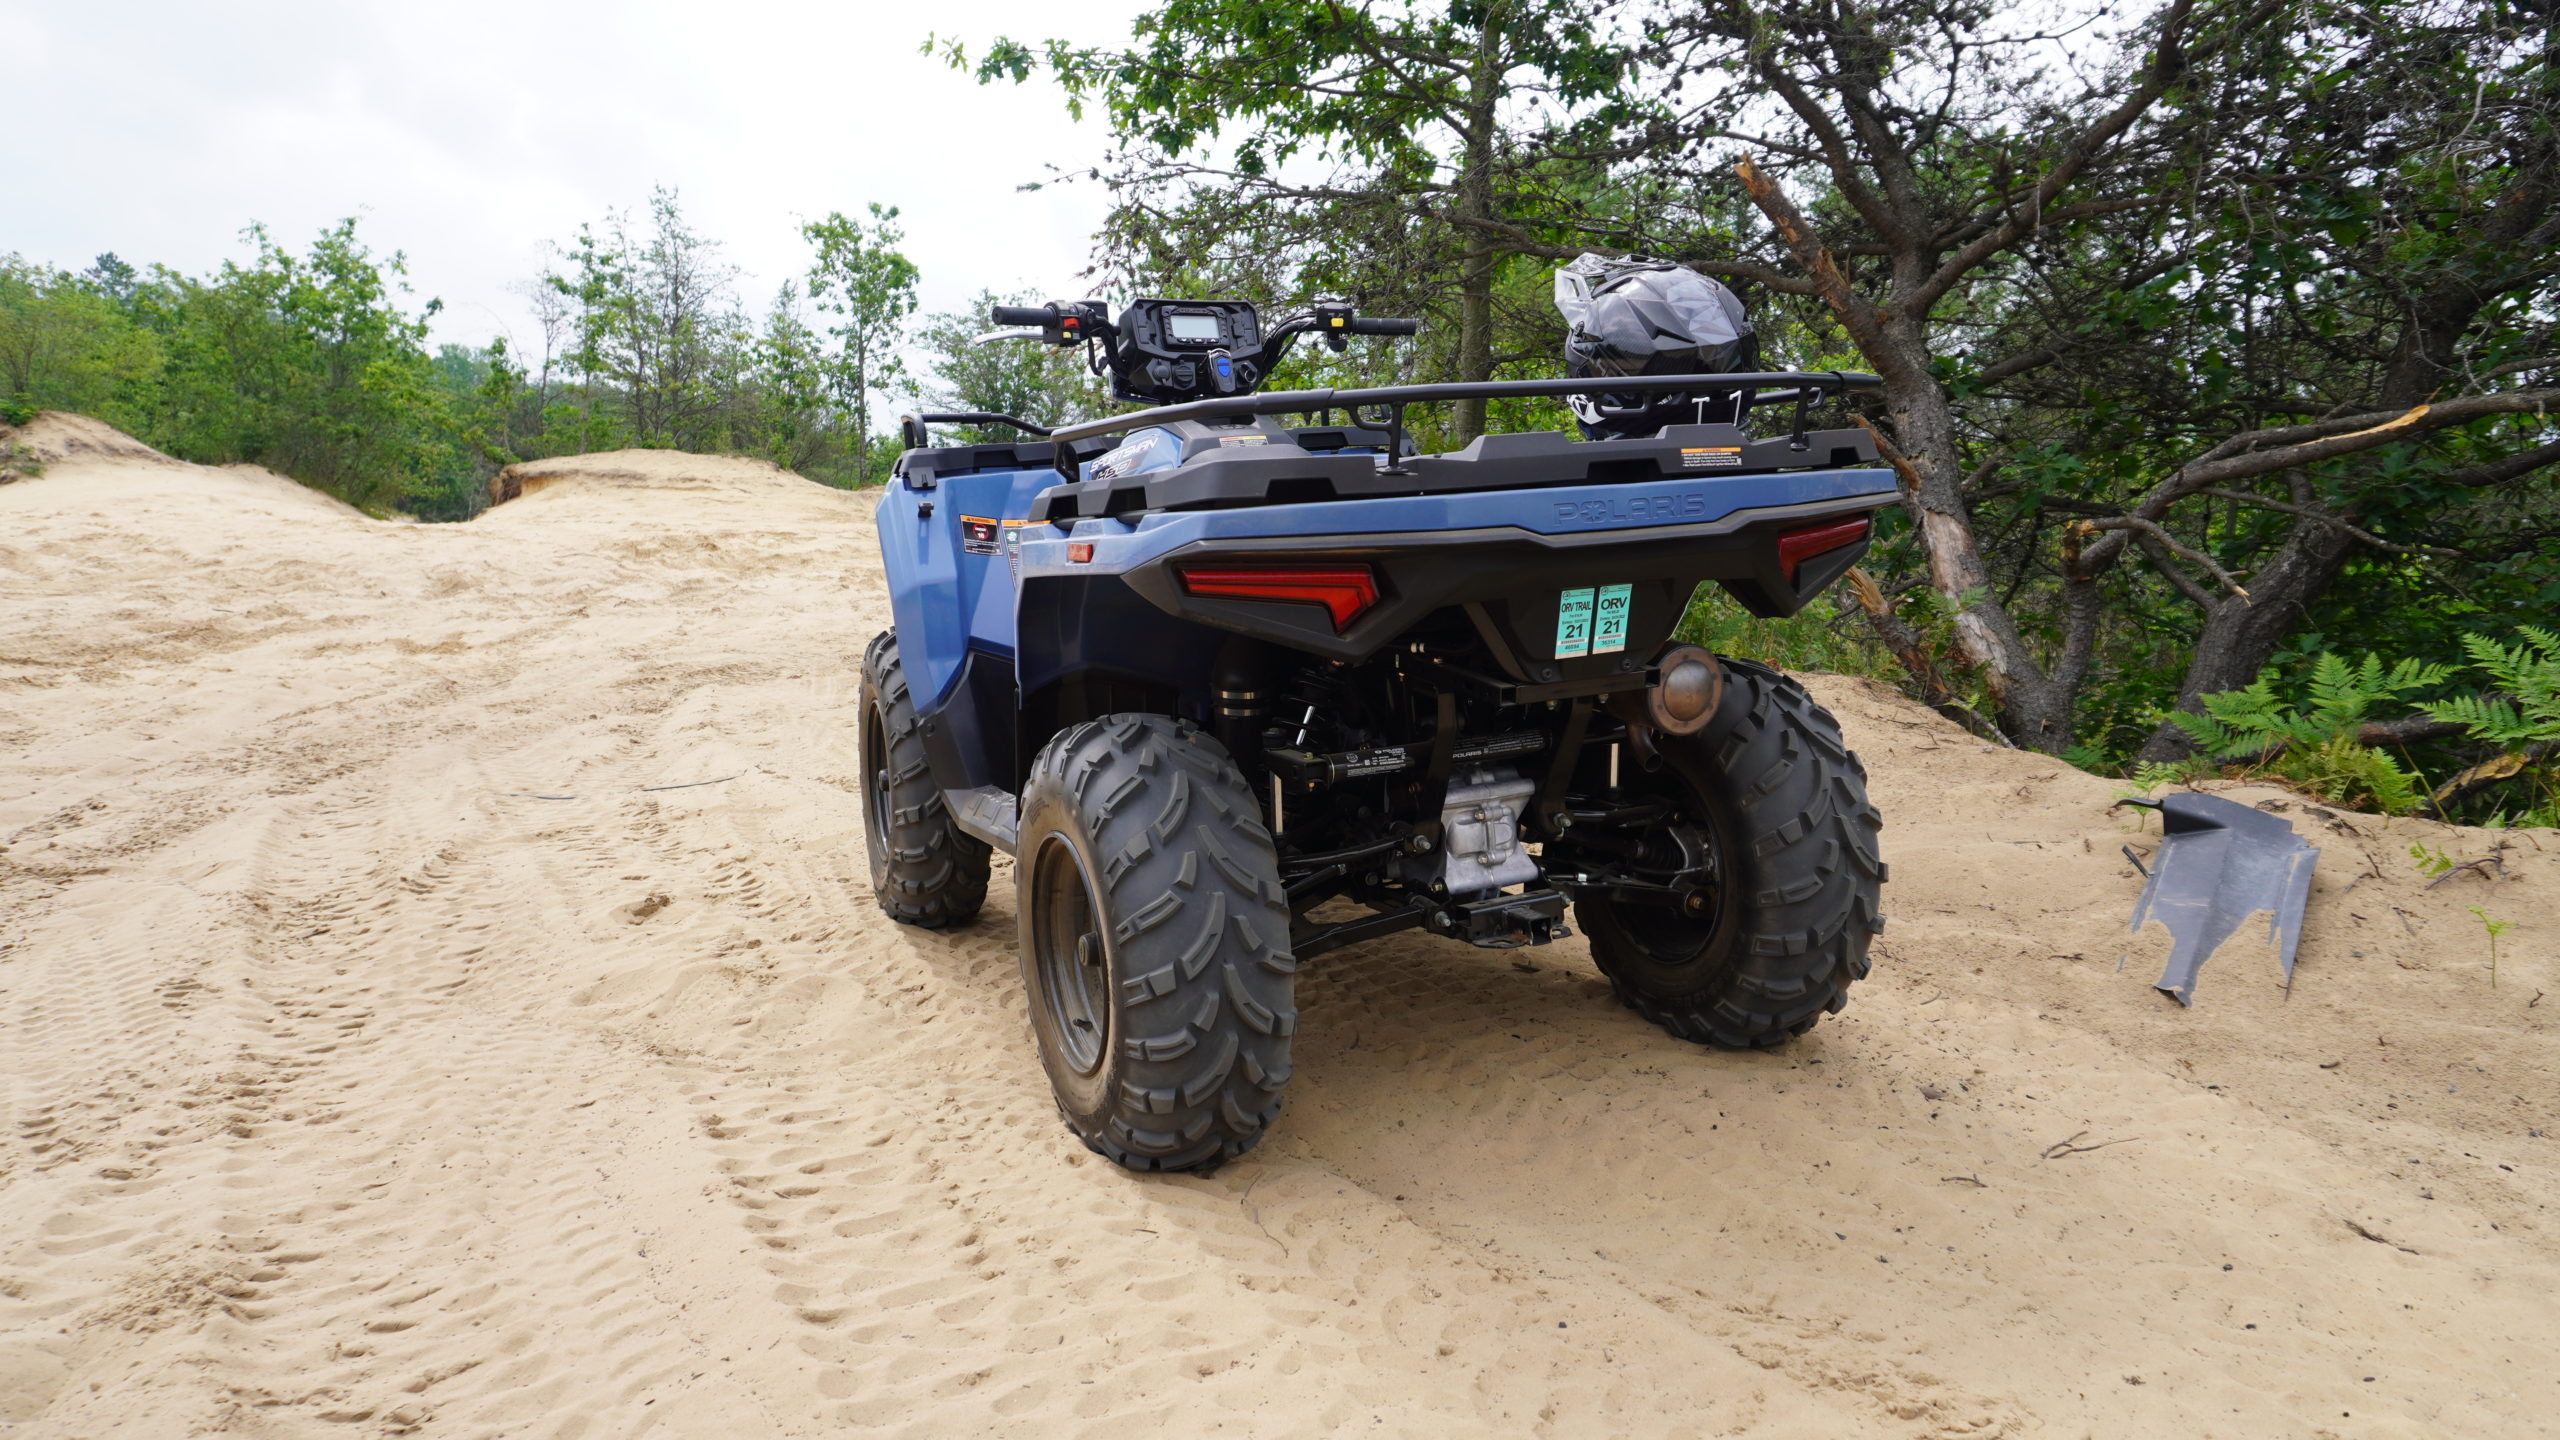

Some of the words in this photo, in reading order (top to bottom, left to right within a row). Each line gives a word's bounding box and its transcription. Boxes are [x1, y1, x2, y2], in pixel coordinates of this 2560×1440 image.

[1089, 437, 1159, 473] SPORTSMAN
[1553, 493, 1706, 527] POLARIS
[1561, 602, 1575, 613] ORV
[1576, 600, 1592, 612] TRAIL
[1601, 596, 1628, 611] ORV
[1565, 623, 1583, 639] 21
[1603, 619, 1620, 635] 21
